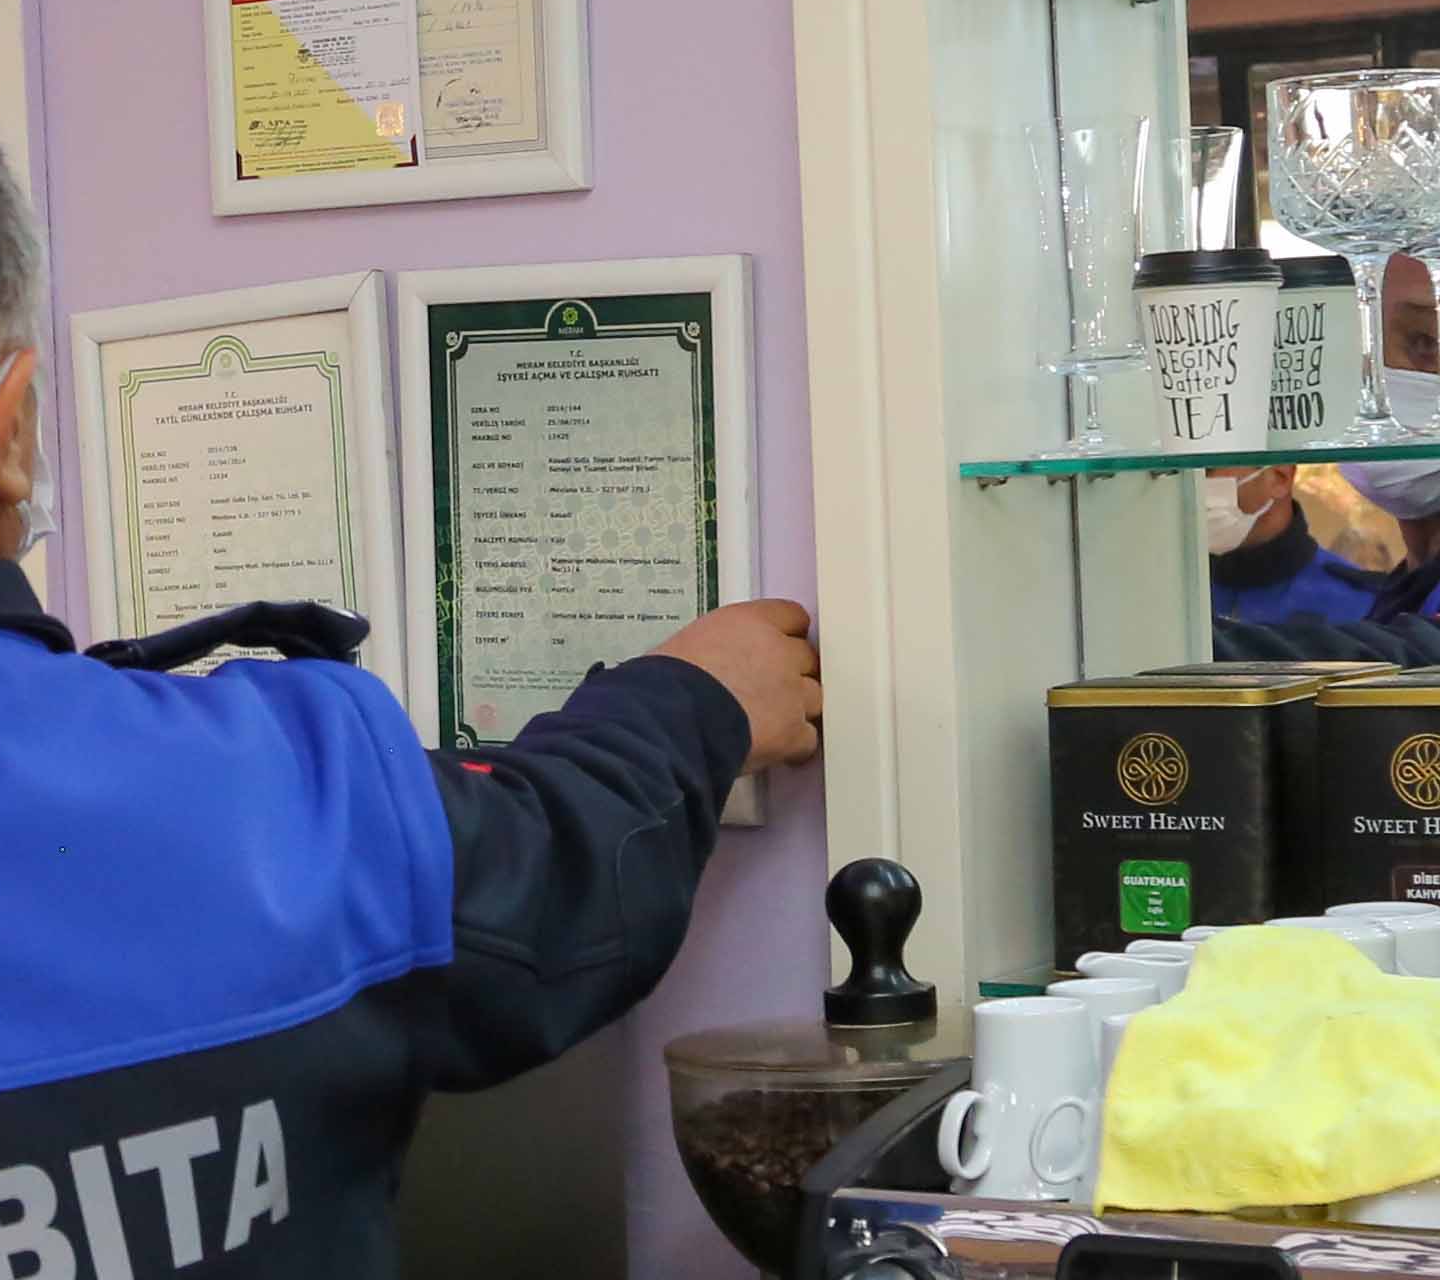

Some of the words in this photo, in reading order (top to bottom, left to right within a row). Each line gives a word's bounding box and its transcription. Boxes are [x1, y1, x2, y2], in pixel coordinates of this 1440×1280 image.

[1148, 298, 1241, 348] MORNING
[531, 371, 558, 383] AÇMA
[560, 371, 572, 380] VE
[1156, 341, 1238, 391] BEGINS
[1176, 369, 1221, 395] after
[1163, 392, 1233, 441] TEA
[1083, 811, 1144, 829] SWEET
[1149, 812, 1225, 831] HEAVEN
[1354, 816, 1418, 834] SWEET
[1123, 876, 1186, 887] GUATEMALA
